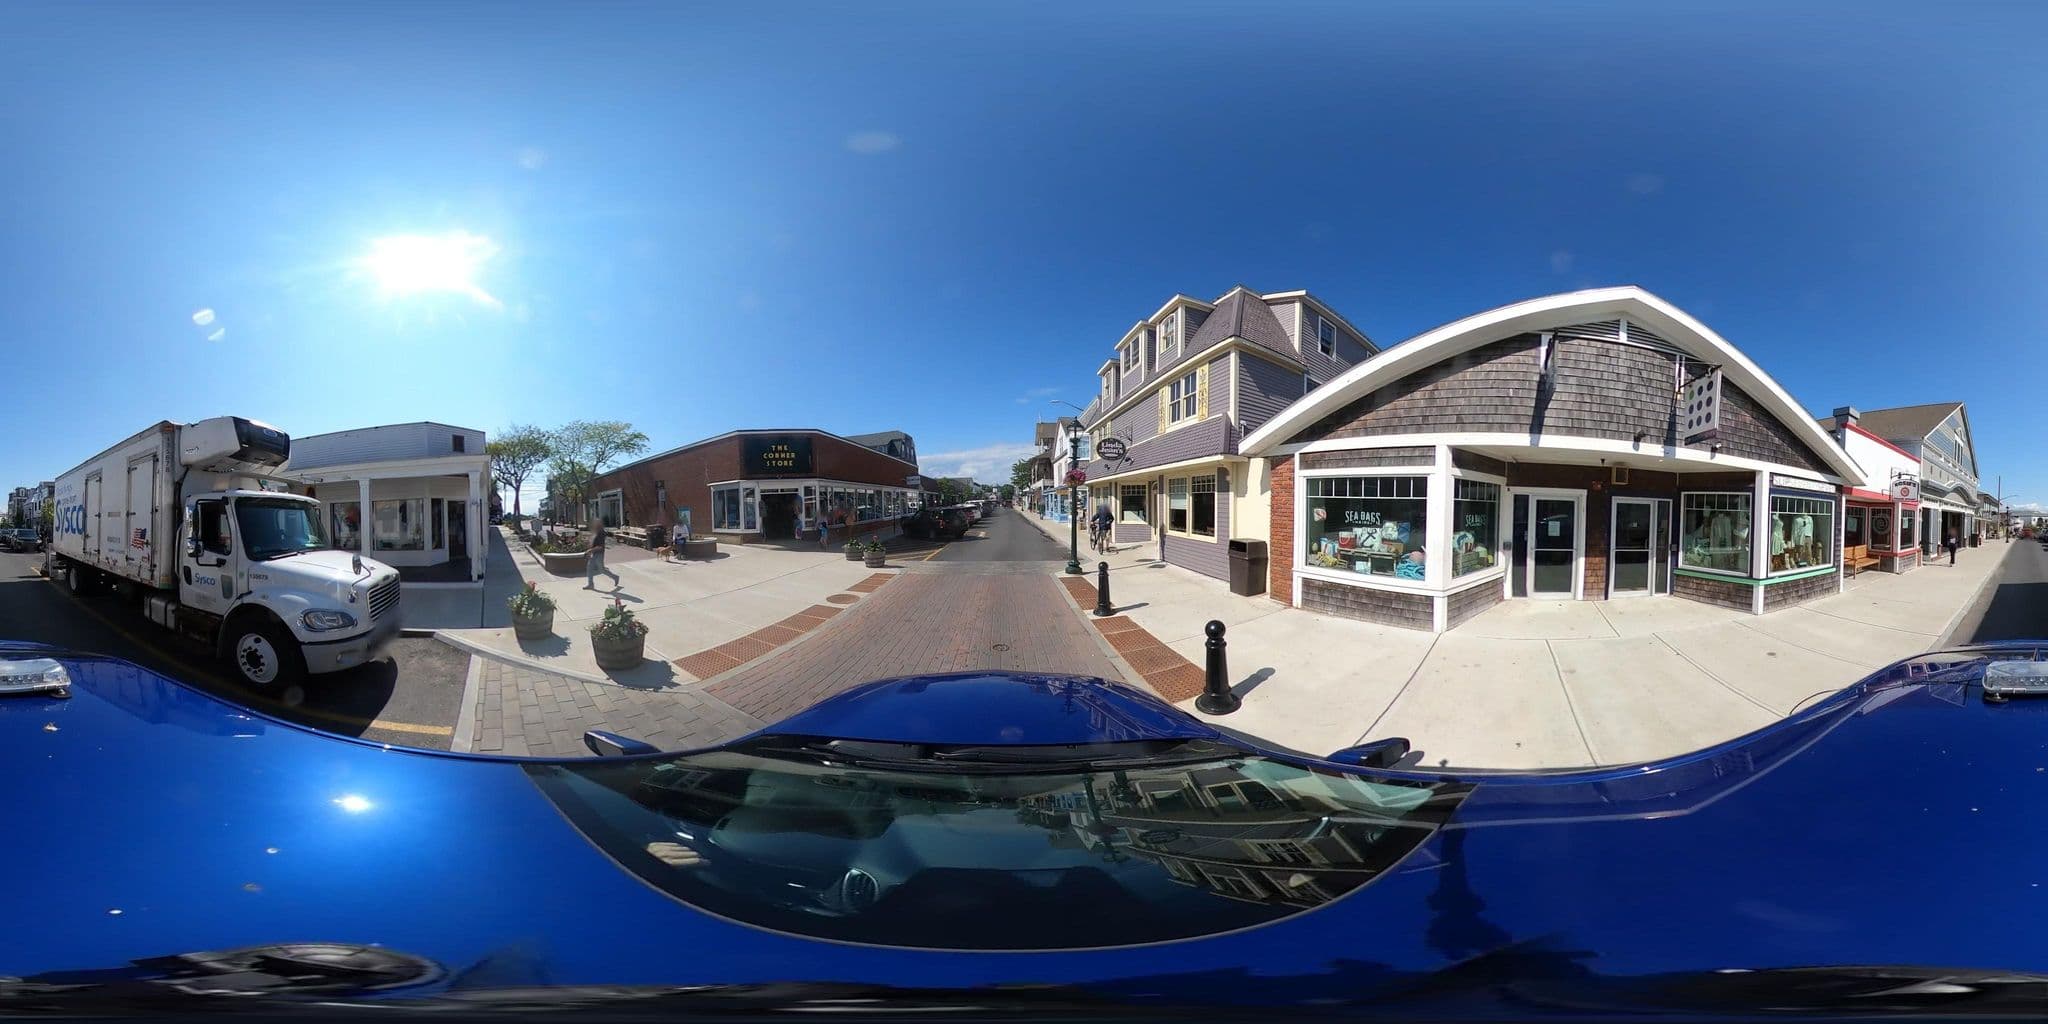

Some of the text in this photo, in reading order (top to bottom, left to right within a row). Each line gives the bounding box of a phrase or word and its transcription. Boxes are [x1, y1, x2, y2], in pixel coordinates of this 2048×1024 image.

[55, 500, 85, 541] Sysco
[1344, 510, 1381, 525] SEA BAGS
[194, 573, 216, 586] Sysco
